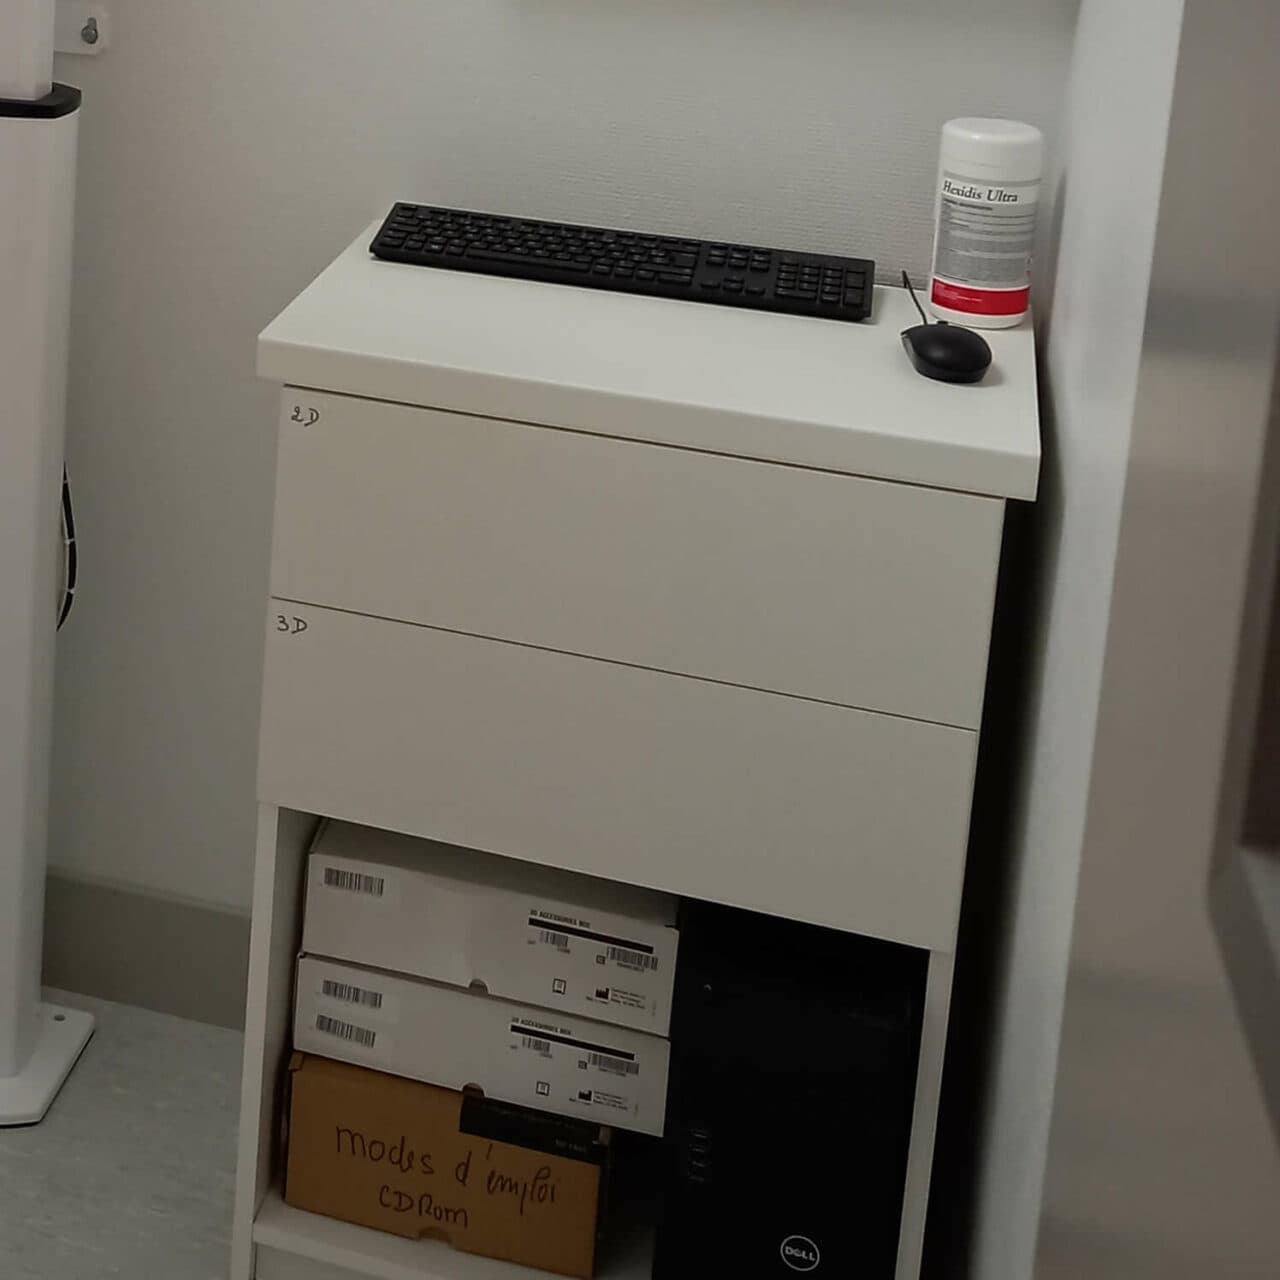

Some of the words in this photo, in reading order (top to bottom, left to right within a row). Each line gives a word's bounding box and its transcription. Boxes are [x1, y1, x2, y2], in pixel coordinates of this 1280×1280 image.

[943, 180, 982, 200] Hexidis
[986, 189, 1018, 203] Ultra
[291, 405, 320, 427] 2D
[277, 615, 308, 634] 3D
[335, 1125, 435, 1175] modes
[784, 1245, 815, 1262] DELL
